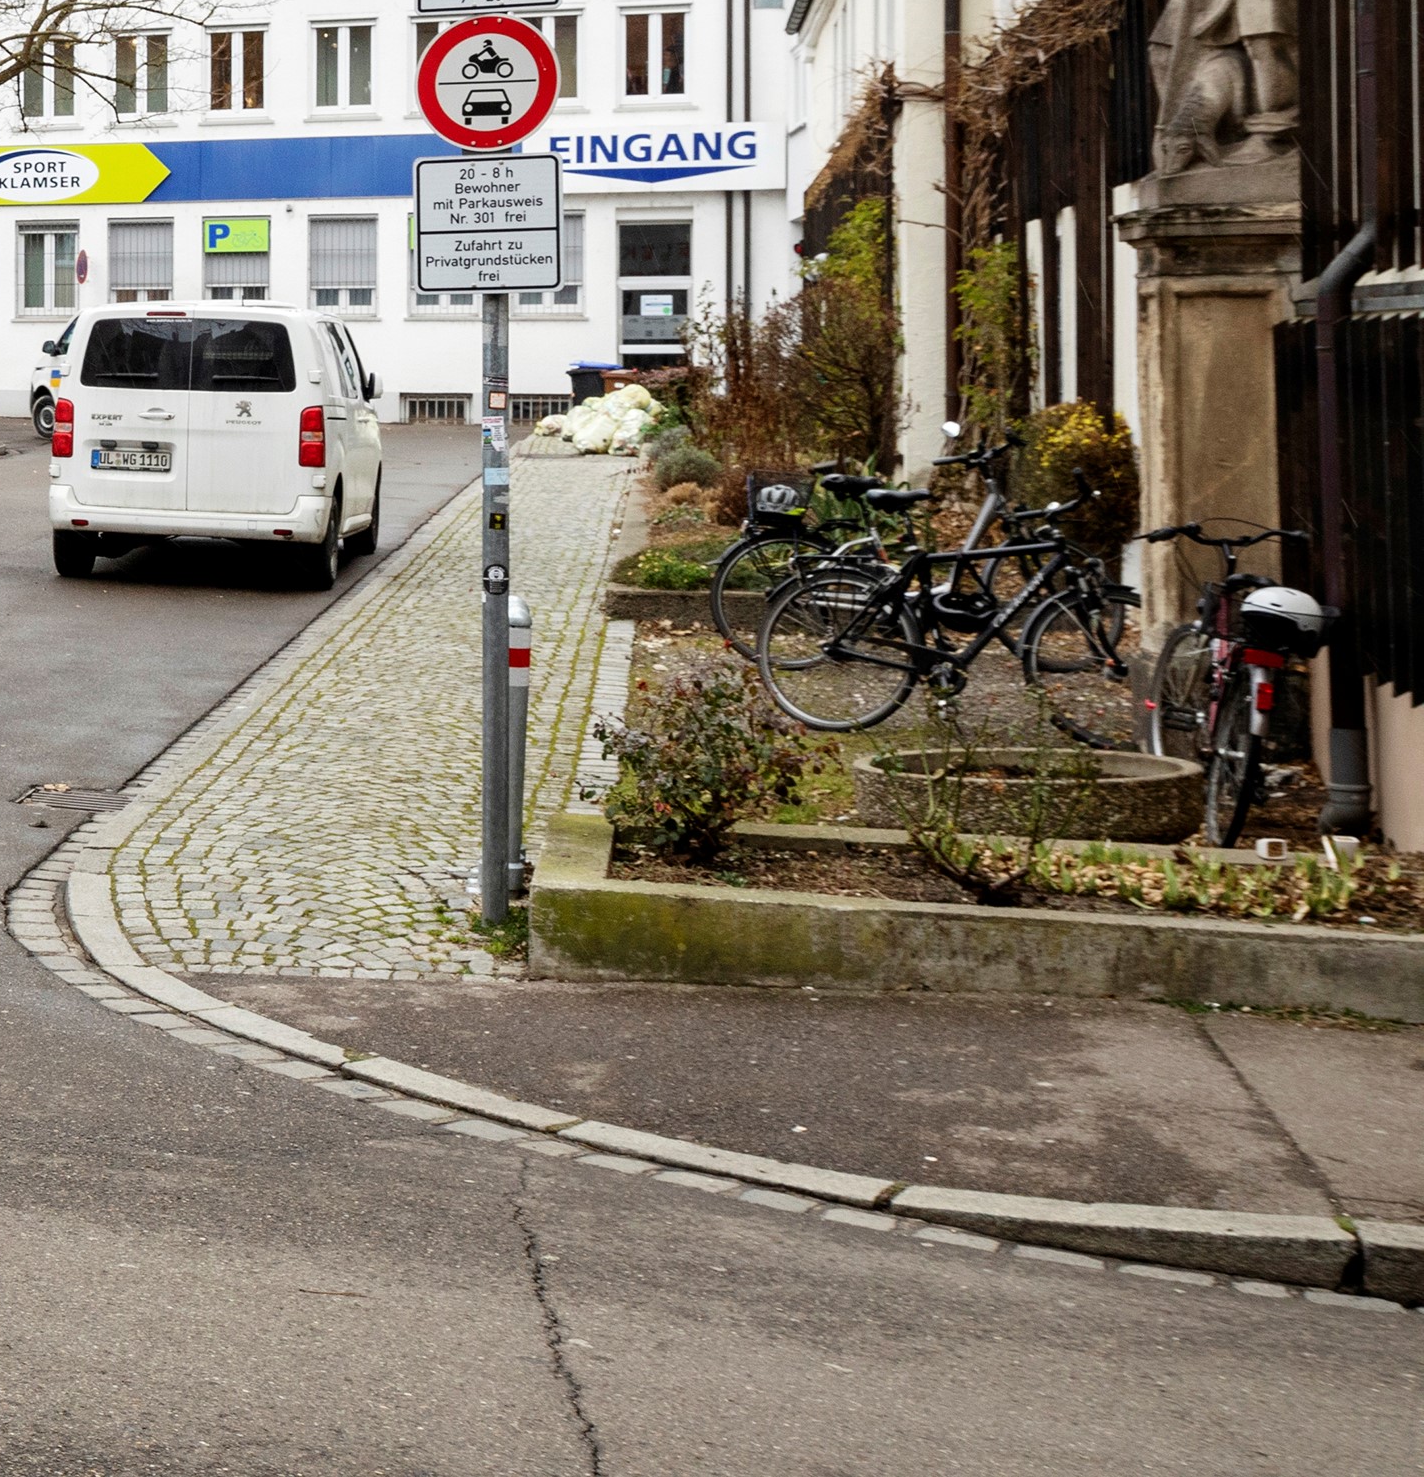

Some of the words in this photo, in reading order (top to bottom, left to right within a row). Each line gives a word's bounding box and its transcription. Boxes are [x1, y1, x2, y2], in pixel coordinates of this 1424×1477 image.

[549, 130, 757, 164] EINGANG
[13, 161, 67, 174] SPORT
[459, 168, 475, 180] 20
[492, 167, 501, 178] 8
[505, 166, 513, 178] h
[455, 182, 521, 194] Bewohner
[433, 198, 454, 210] mit
[459, 195, 543, 210] Parkausweis
[449, 212, 469, 224] Nr.
[473, 212, 495, 224] 301
[505, 210, 527, 223] frei
[209, 224, 231, 248] P
[454, 240, 503, 252] Zufahrt
[507, 241, 523, 250] zu
[425, 253, 553, 270] Privatgrundstücken
[477, 270, 500, 282] frei
[99, 452, 113, 464] UL
[122, 453, 137, 466] WG
[139, 454, 168, 467] 1110
